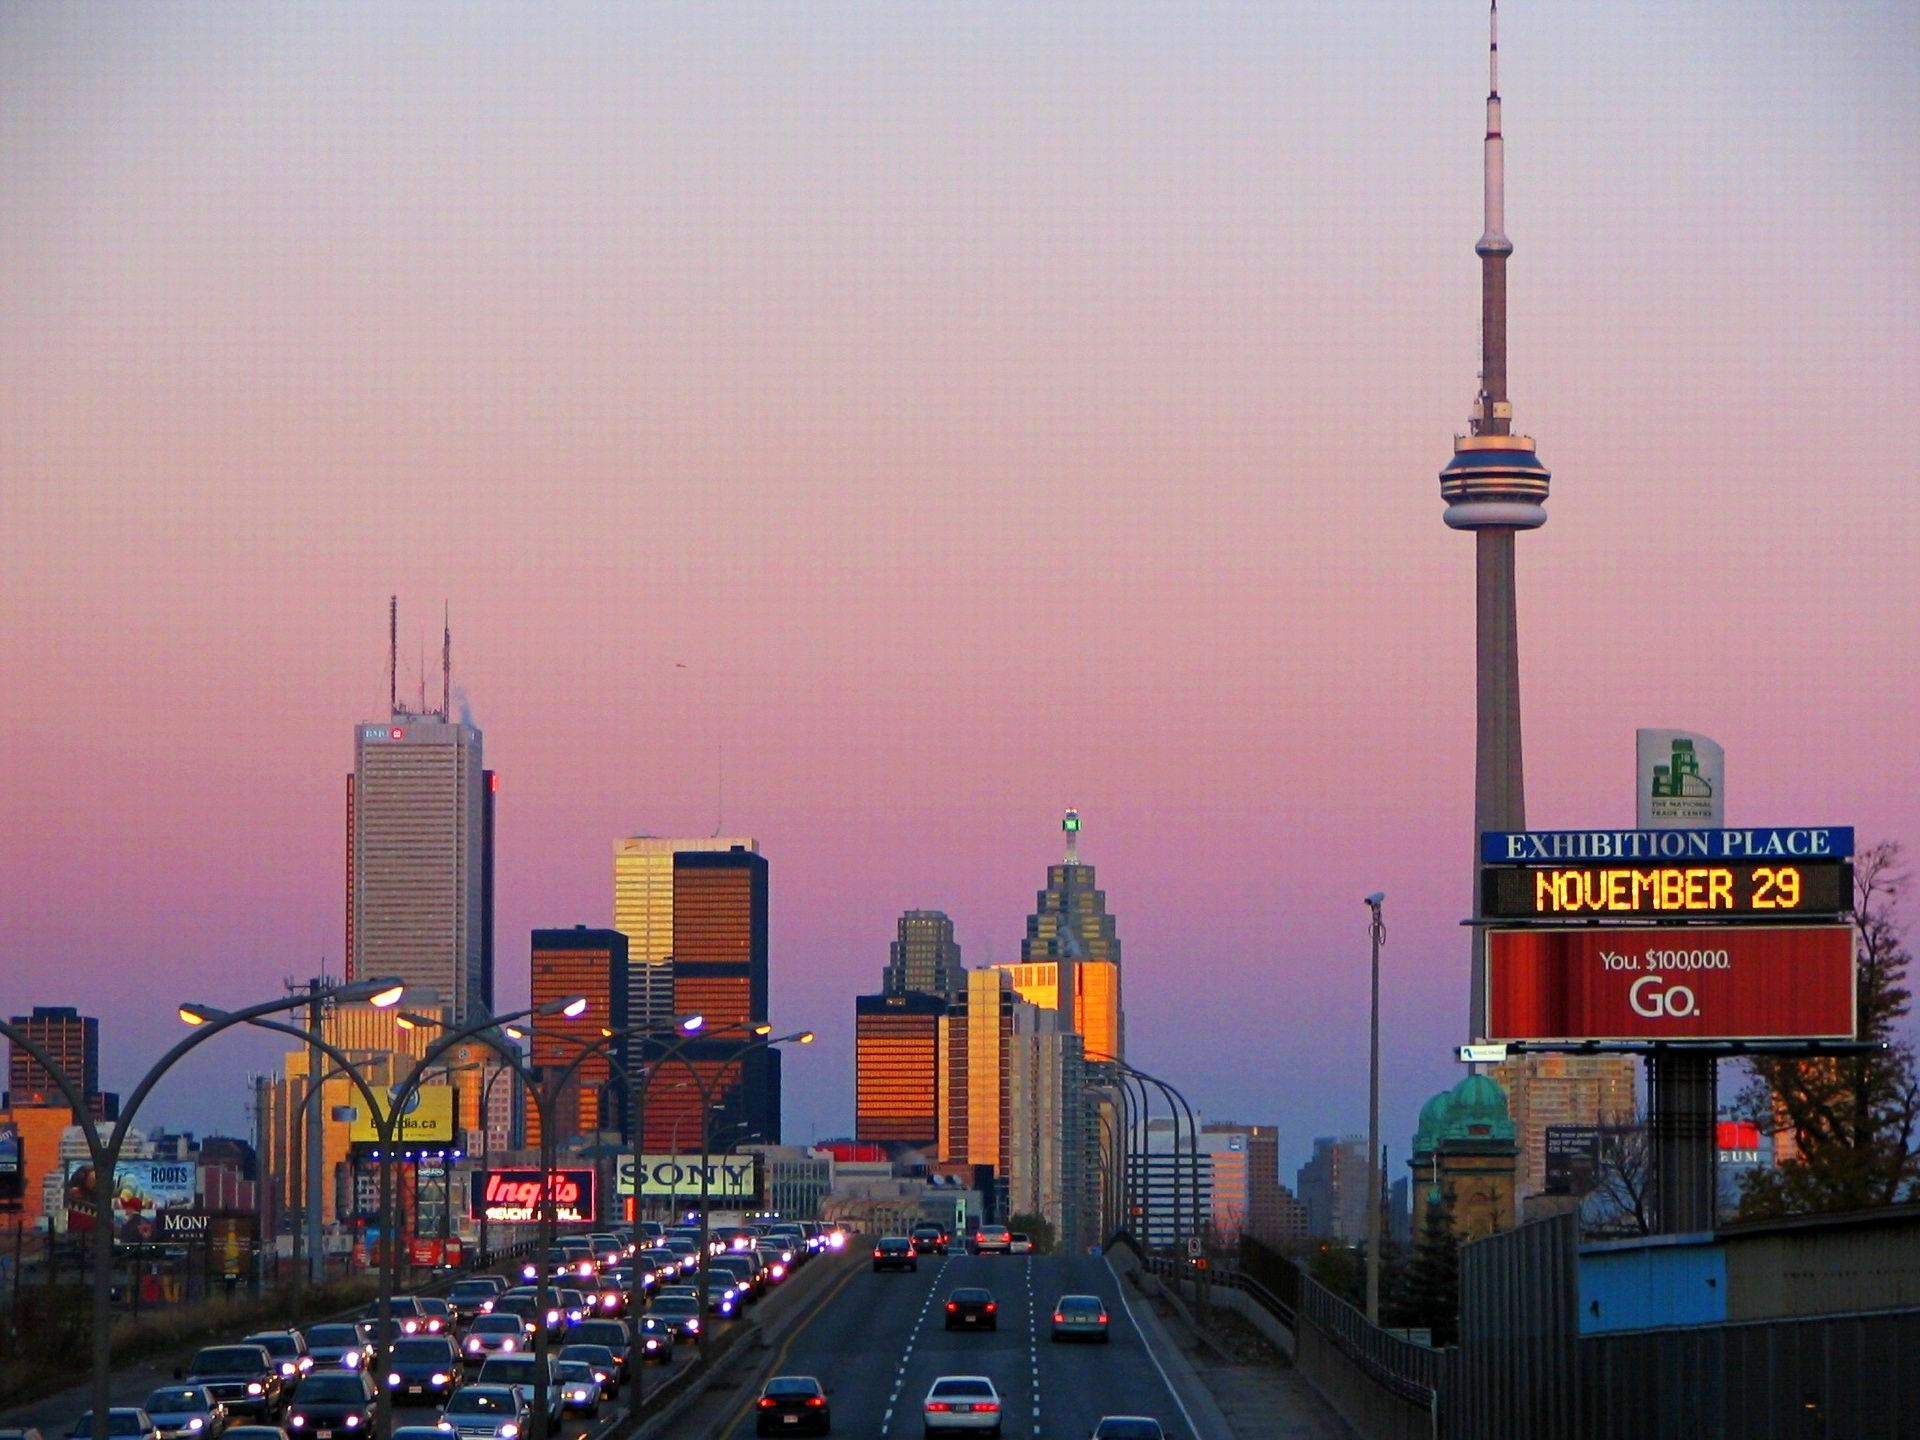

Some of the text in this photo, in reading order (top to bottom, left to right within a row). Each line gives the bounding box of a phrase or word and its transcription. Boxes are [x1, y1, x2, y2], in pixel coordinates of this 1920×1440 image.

[1506, 830, 1830, 858] EXHIBITION PLACE
[1537, 868, 1799, 911] NOVEMBER 29
[1600, 949, 1730, 971] You. $100,000.
[1630, 975, 1701, 1018] Go.
[151, 1167, 188, 1183] ROOTS
[620, 1163, 752, 1186] SONY
